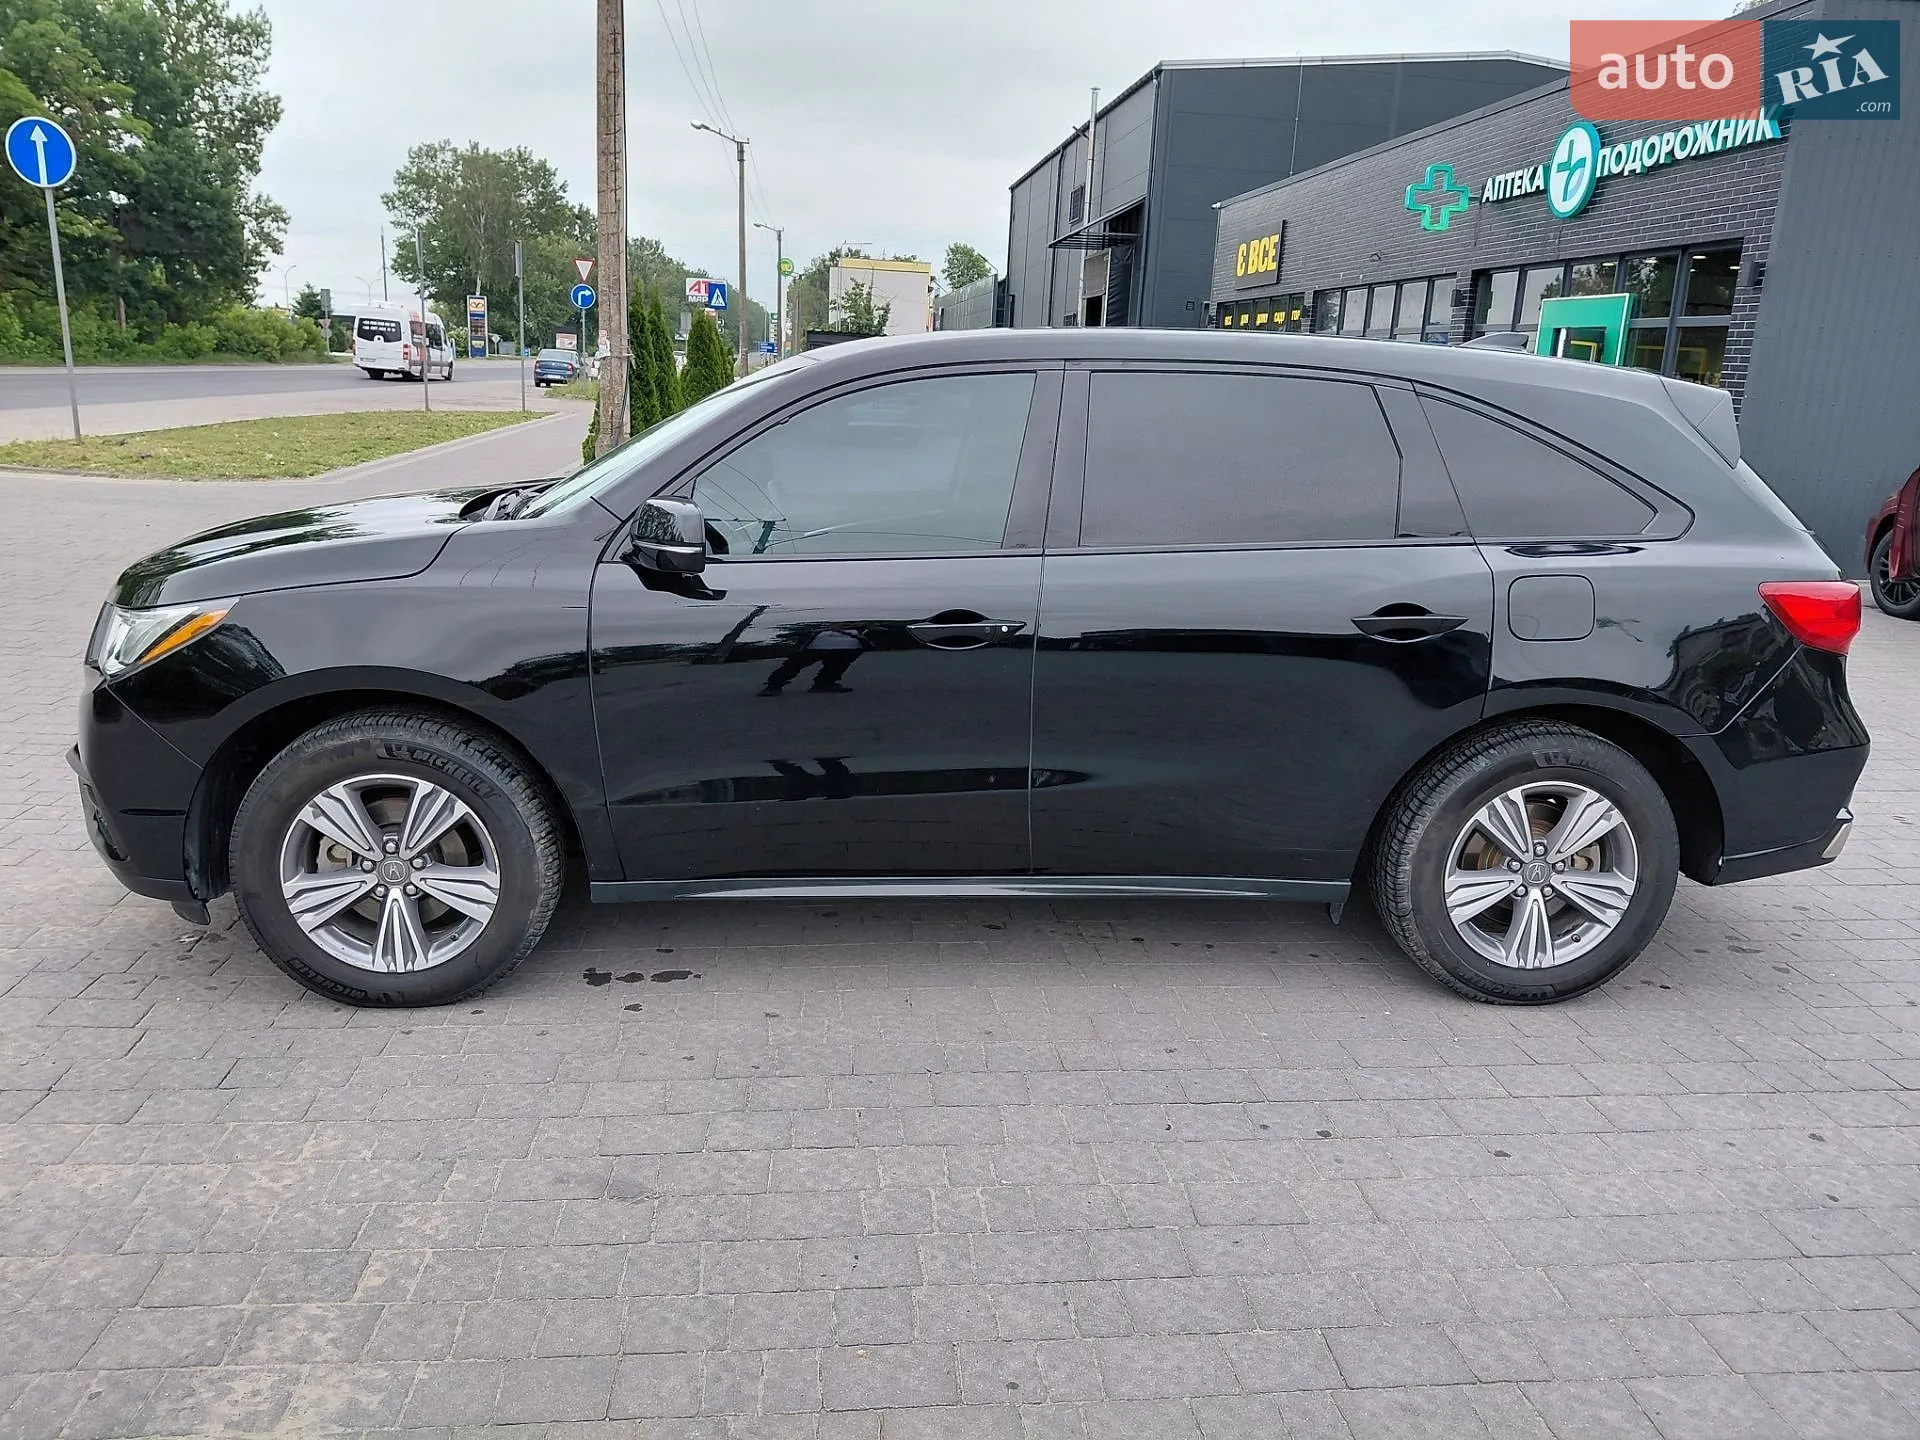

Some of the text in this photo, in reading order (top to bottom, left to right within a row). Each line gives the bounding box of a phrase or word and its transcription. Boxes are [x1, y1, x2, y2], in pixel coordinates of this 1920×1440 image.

[1482, 105, 1782, 204] АПТЕКА ПОДОРОЖНИК
[1247, 234, 1279, 274] ВСЕ
